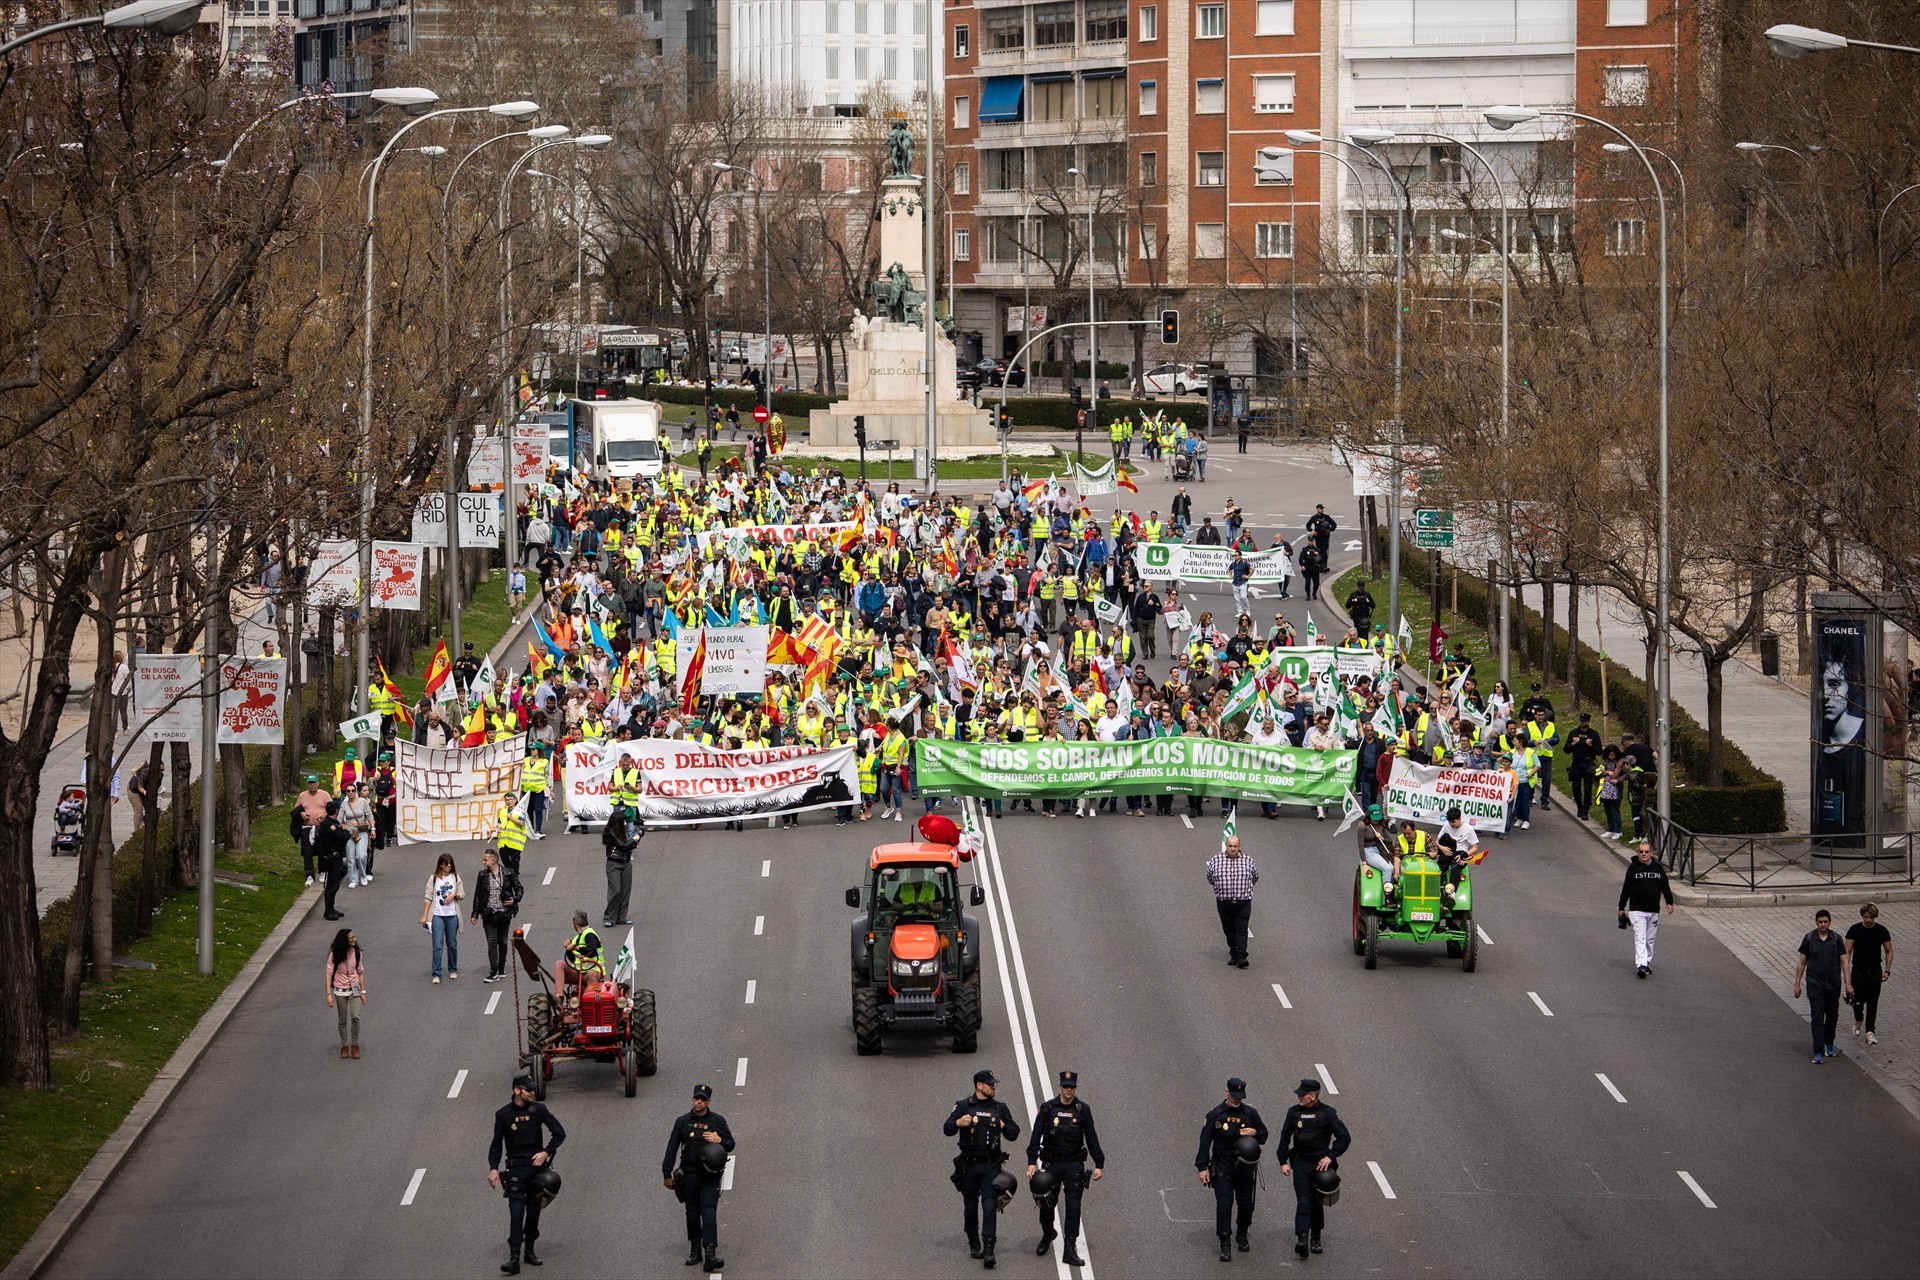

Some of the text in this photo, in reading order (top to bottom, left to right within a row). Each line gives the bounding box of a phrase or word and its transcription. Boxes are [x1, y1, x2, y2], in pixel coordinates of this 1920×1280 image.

[460, 497, 491, 510] CUL
[421, 511, 445, 523] RID
[465, 511, 486, 523] TU
[476, 524, 497, 538] RA
[1189, 551, 1212, 560] Unión
[1213, 551, 1223, 560] de
[1183, 559, 1224, 568] Ganaderos
[1225, 561, 1230, 570] y
[1142, 568, 1172, 576] UGAMA
[1180, 566, 1189, 574] de
[1191, 567, 1198, 575] la
[1255, 568, 1282, 577] Madrid
[398, 588, 418, 597] VIDA
[1823, 626, 1859, 635] CHANEL
[707, 635, 726, 644] MUNDO
[726, 635, 745, 643] RURAL
[708, 648, 735, 661] VIVO
[227, 668, 279, 680] Stephanie
[228, 677, 278, 692] Comilang
[225, 707, 278, 718] EN BUSCA
[222, 716, 281, 728] DE LA VIDA
[401, 741, 425, 771] EL
[430, 744, 497, 772] CAMPO
[574, 752, 601, 768] NO
[980, 742, 1297, 774] NOS SOBRAN LOS MOTIVOS
[401, 763, 523, 800] MUERE 2030
[645, 764, 819, 797] AGRICULTORES
[981, 772, 1045, 783] DEFENDEMOS
[1048, 775, 1059, 783] EL
[1062, 771, 1098, 783] CAMPO,
[1100, 767, 1164, 780] DEFENDEMOS
[1166, 767, 1178, 777] LA
[1180, 767, 1247, 781] ALIMENTACIÓN
[1249, 772, 1262, 783] DE
[1263, 774, 1295, 787] TODOS
[1394, 778, 1422, 789] ADECCU
[1437, 770, 1506, 788] ASOCIACIÓN
[1435, 782, 1503, 801] EN DEFENSA
[1388, 789, 1408, 806] DEL
[1410, 792, 1446, 812] CAMPO
[1463, 800, 1503, 819] CUENCA
[402, 805, 428, 835] EL
